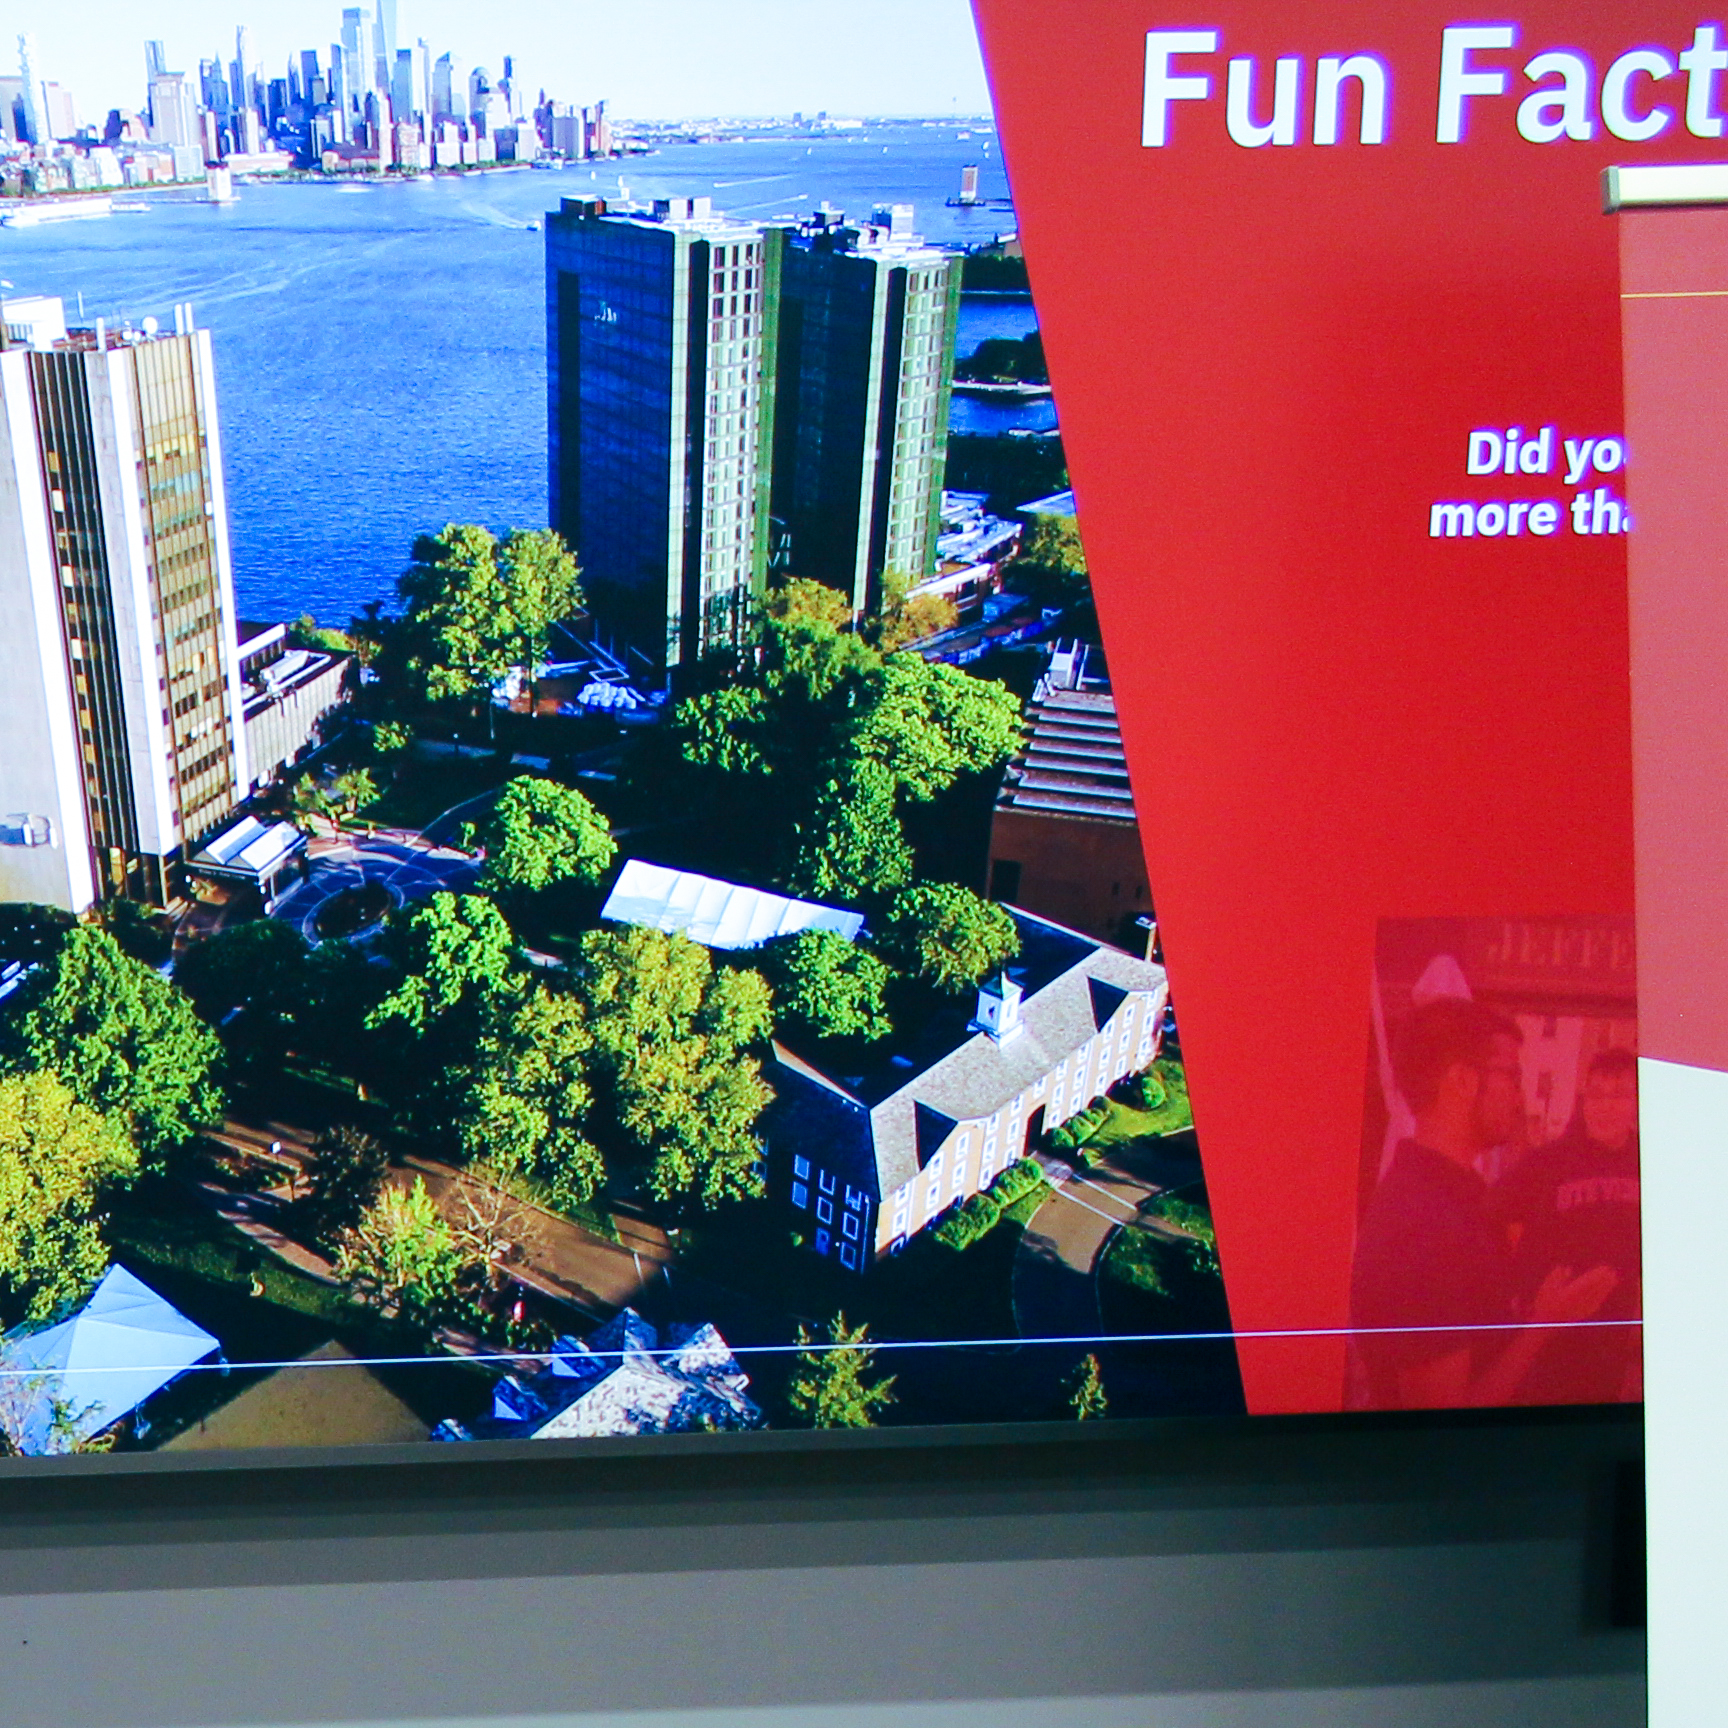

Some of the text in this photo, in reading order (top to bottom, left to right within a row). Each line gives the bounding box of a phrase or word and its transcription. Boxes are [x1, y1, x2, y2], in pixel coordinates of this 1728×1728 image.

[1142, 27, 1728, 148] Fun Fact
[1467, 428, 1626, 485] Did yo
[1430, 502, 1557, 537] more
